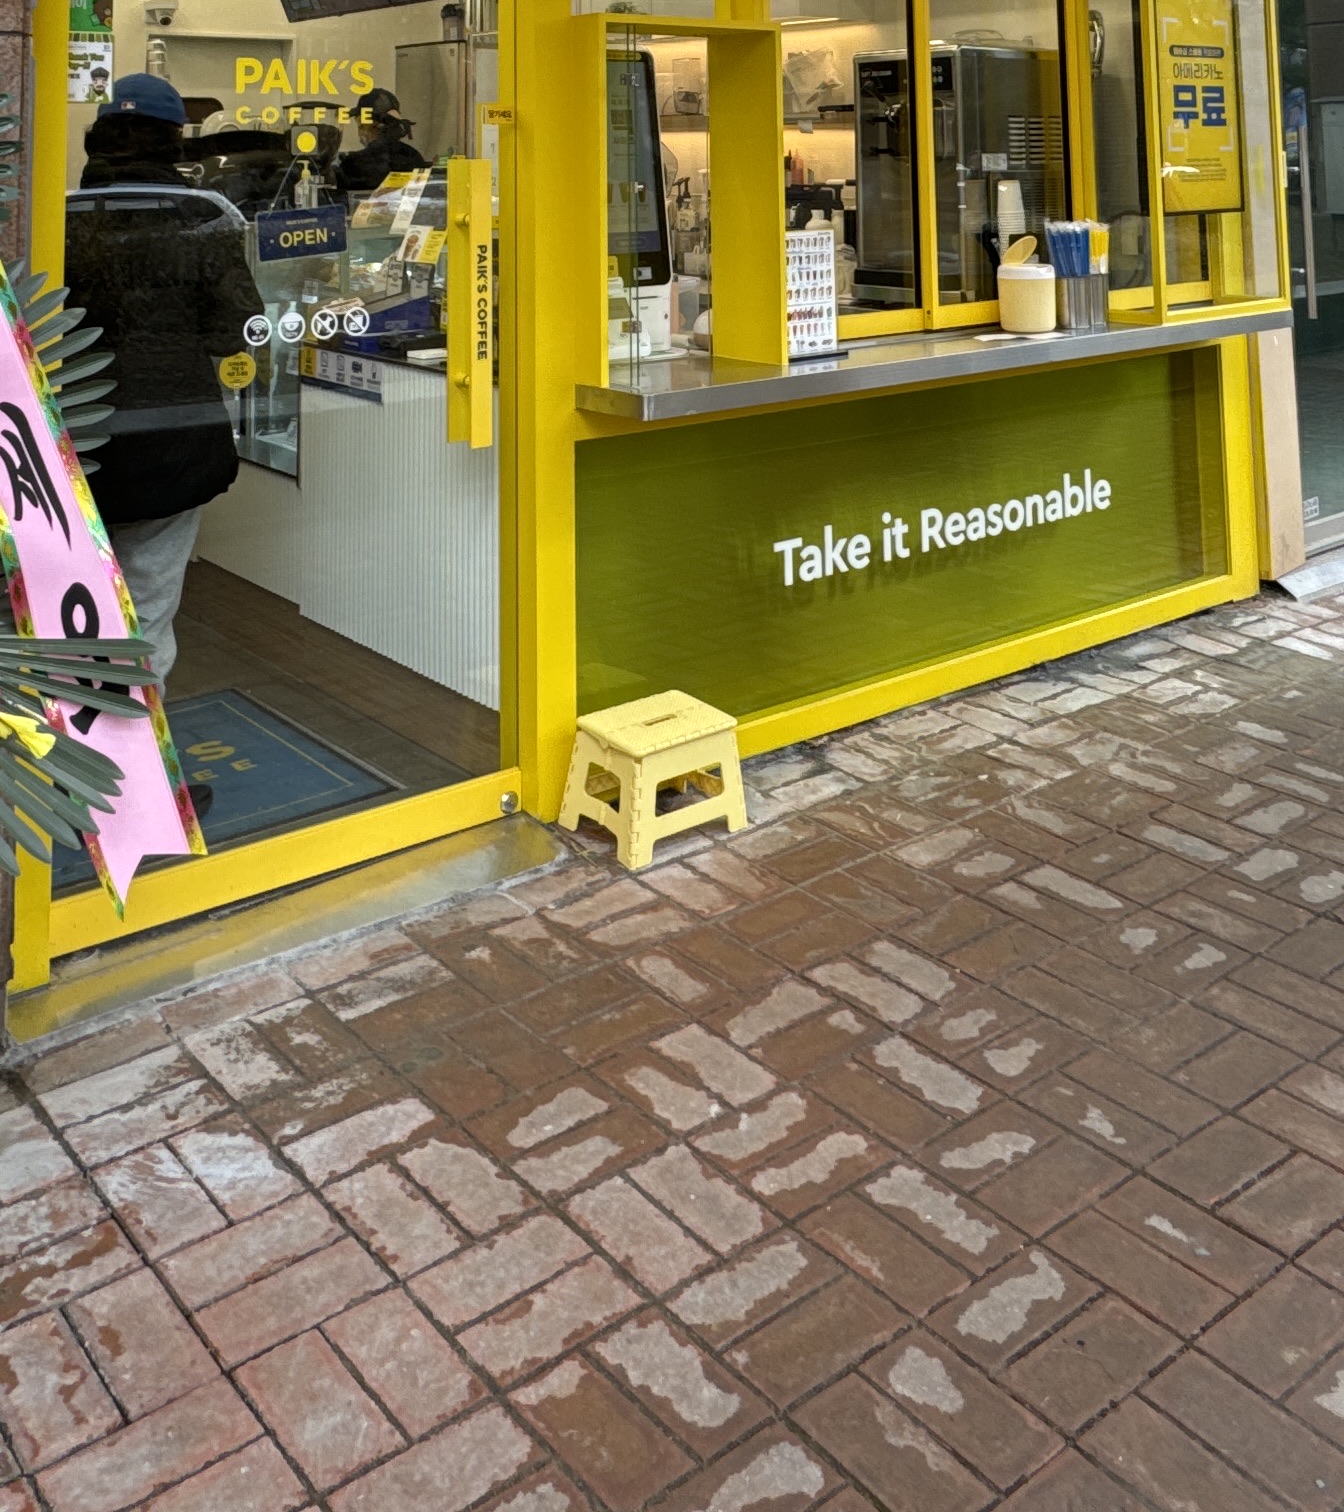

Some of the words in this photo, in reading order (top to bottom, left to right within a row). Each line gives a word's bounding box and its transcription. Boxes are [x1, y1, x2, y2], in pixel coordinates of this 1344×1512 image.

[235, 56, 376, 95] PAIK'S
[1172, 62, 1225, 80] 아메리카노
[235, 106, 374, 125] COFFEE
[1172, 84, 1228, 130] 무료
[279, 227, 328, 248] OPEN
[476, 244, 488, 293] PAIK'S
[476, 297, 488, 361] COFFEE
[773, 524, 871, 589] Take
[882, 511, 910, 560] it
[921, 468, 1113, 551] Reasonable
